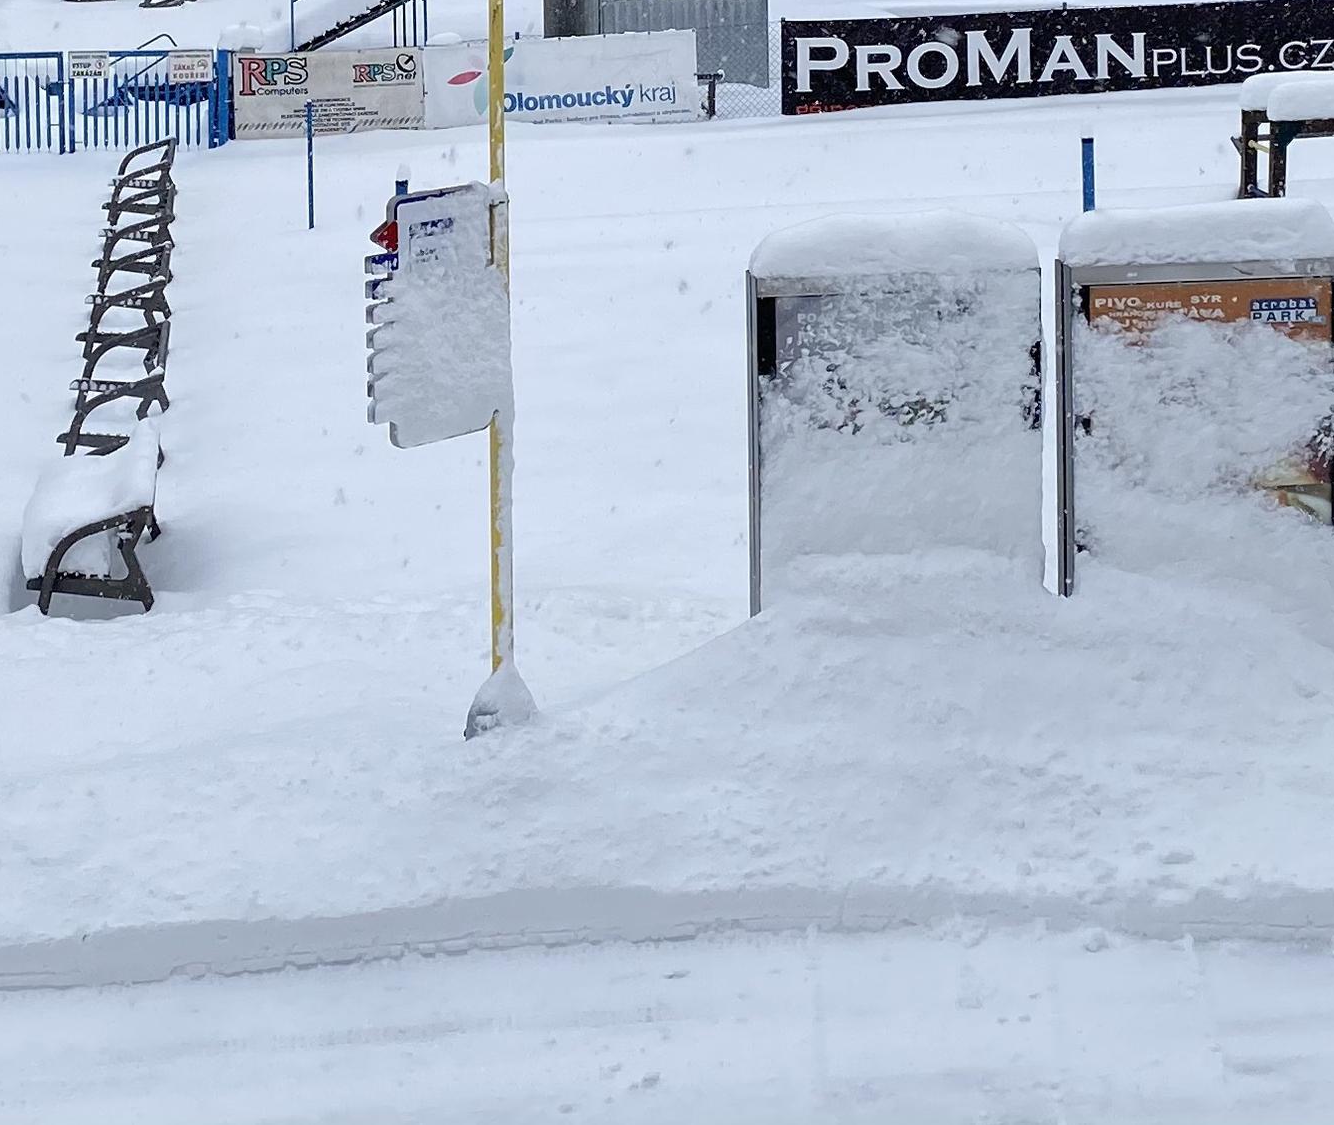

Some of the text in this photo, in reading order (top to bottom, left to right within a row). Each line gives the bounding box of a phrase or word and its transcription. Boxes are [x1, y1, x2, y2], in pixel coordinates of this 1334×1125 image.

[239, 57, 309, 96] RPS
[353, 63, 396, 83] RPS
[256, 86, 309, 96] Computers
[639, 81, 676, 104] kraj
[1095, 297, 1141, 309] PIVO
[1252, 298, 1315, 310] acrobat
[1252, 310, 1306, 322] PARK
